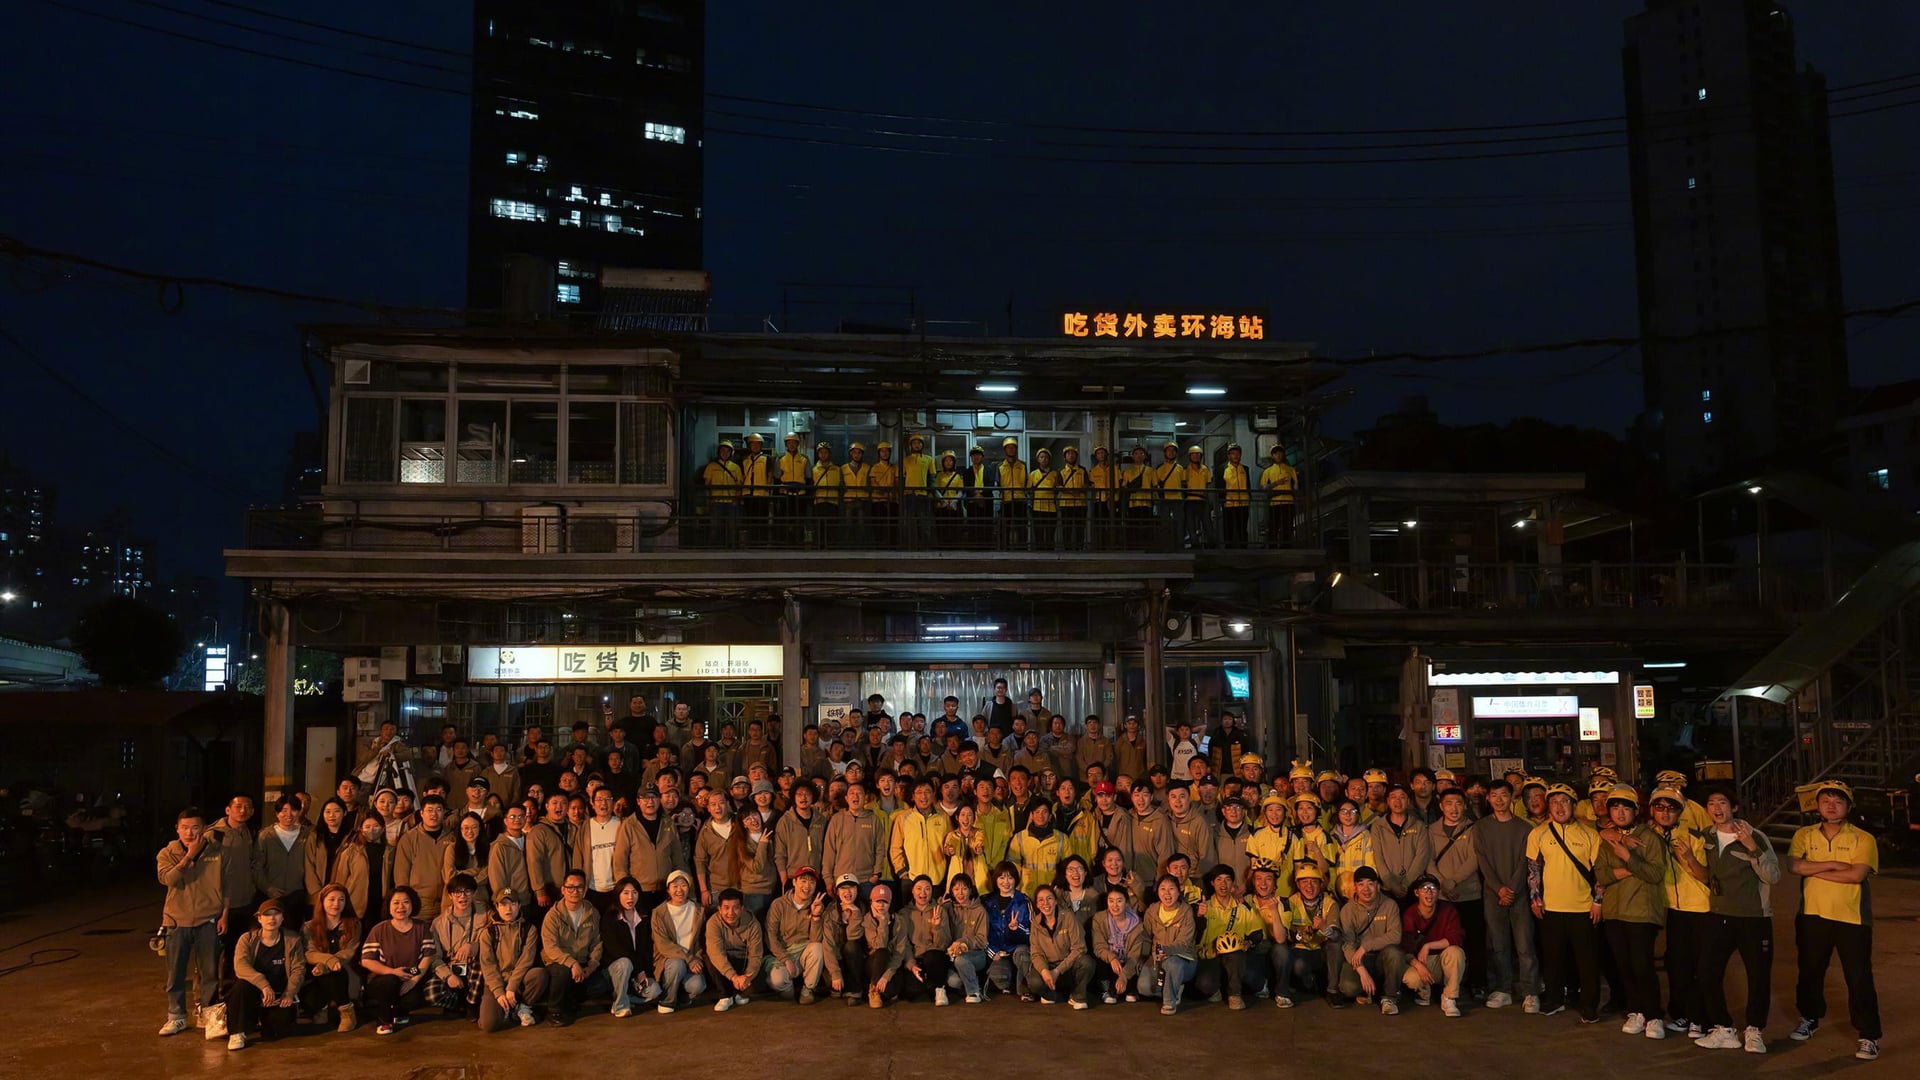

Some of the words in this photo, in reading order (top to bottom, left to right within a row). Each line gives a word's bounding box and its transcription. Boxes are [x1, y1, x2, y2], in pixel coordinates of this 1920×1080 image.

[1063, 312, 1264, 339] 吃货外卖环海站
[563, 652, 682, 674] 吃货外卖
